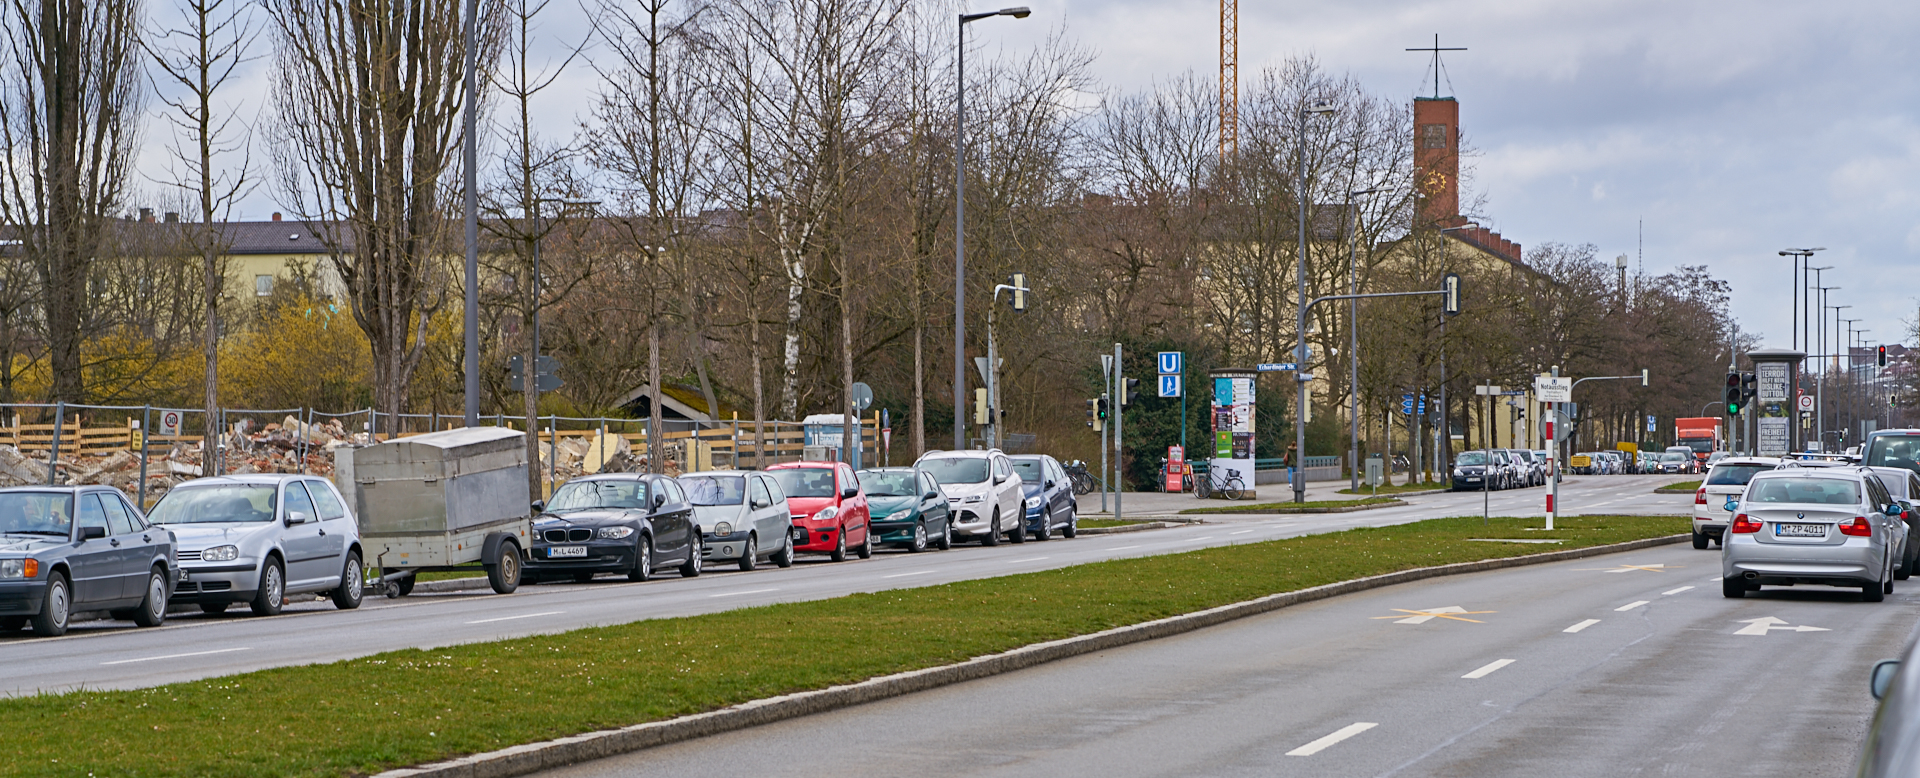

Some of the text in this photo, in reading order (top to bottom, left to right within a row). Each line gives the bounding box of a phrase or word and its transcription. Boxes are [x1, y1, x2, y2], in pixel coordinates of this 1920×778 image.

[1162, 354, 1176, 372] U
[1762, 370, 1785, 378] TERROR
[1541, 383, 1568, 392] Notausstieg
[168, 416, 175, 424] 30
[1781, 525, 1823, 533] M ZP 4011
[568, 547, 584, 555] 4469
